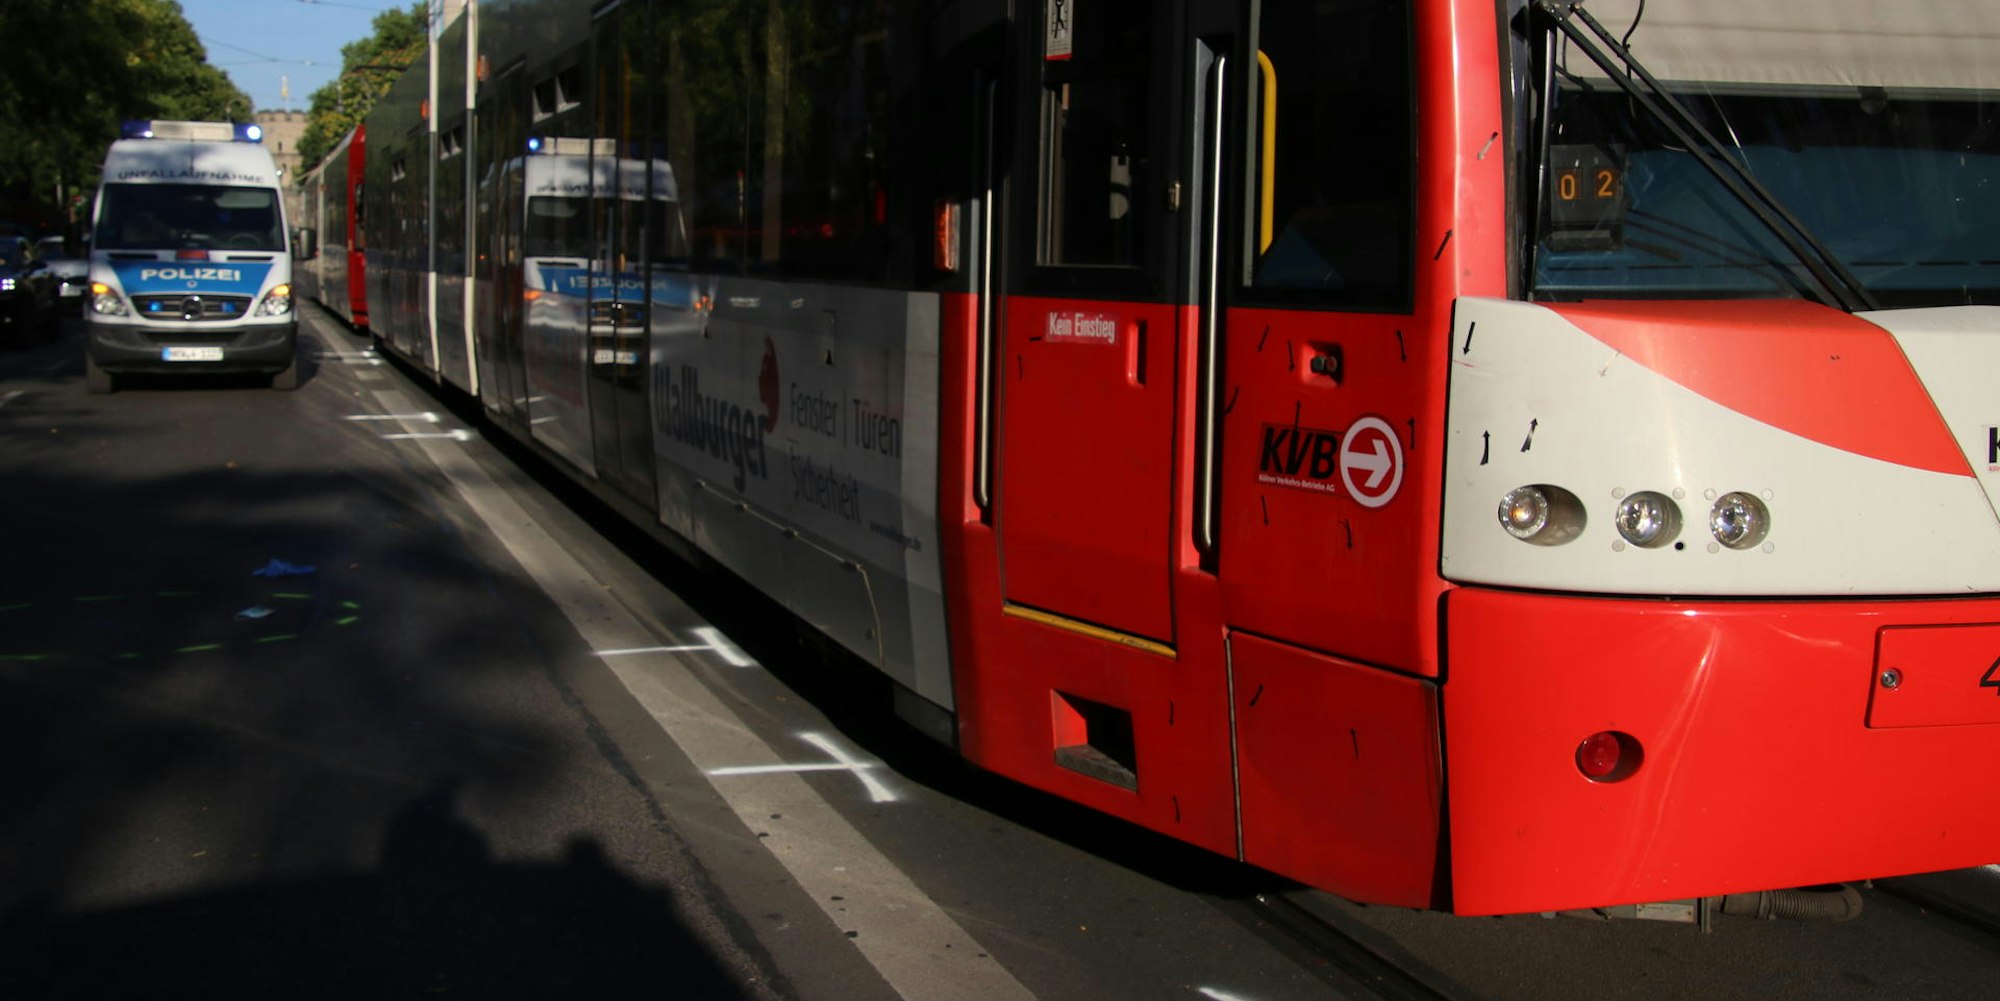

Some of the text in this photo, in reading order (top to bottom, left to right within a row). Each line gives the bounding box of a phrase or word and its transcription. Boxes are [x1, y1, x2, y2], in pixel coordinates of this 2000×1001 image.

[141, 267, 241, 281] POLIZEI
[1049, 312, 1115, 344] Kein Einstieg
[654, 364, 768, 493] Wallburger
[790, 381, 901, 460] Fenster Türen
[1260, 427, 1338, 479] KVB
[790, 450, 861, 525] Sicherheit
[1325, 484, 1336, 493] AG
